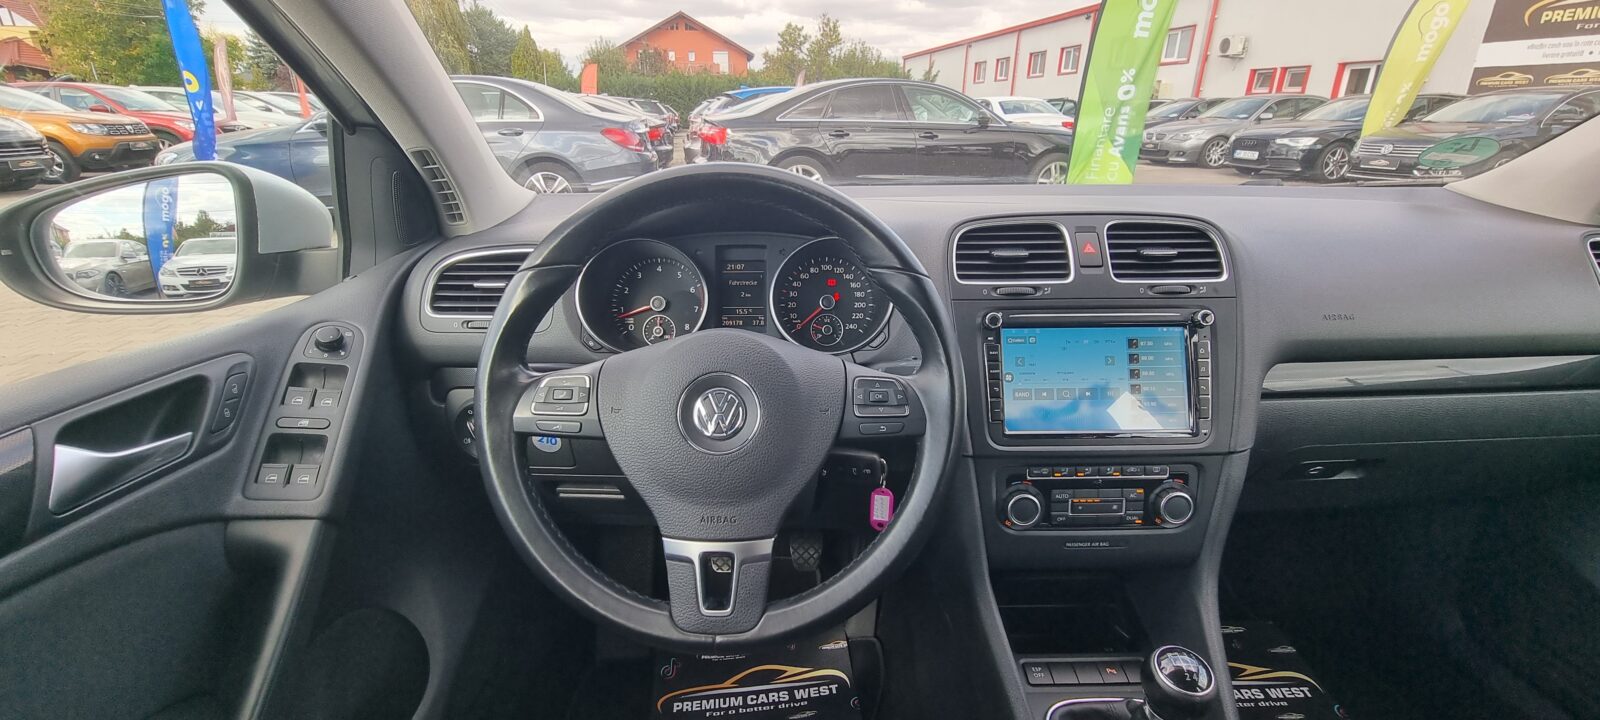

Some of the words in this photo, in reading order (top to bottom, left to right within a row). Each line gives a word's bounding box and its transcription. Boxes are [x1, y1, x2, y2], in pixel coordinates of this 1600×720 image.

[1416, 3, 1450, 62] mogo
[1117, 68, 1137, 101] 0%
[1109, 106, 1132, 158] Avans
[1107, 161, 1121, 182] cu
[162, 186, 173, 222] mogo
[684, 323, 690, 331] 8
[700, 515, 737, 524] AIRBAG
[1185, 673, 1191, 681] 2
[673, 695, 743, 713] PREMIUM
[746, 690, 790, 705] CARS
[794, 684, 839, 700] WEST
[1232, 688, 1265, 699] ARS
[1265, 686, 1312, 698] WEST
[739, 704, 774, 713] better
[778, 700, 808, 710] drive
